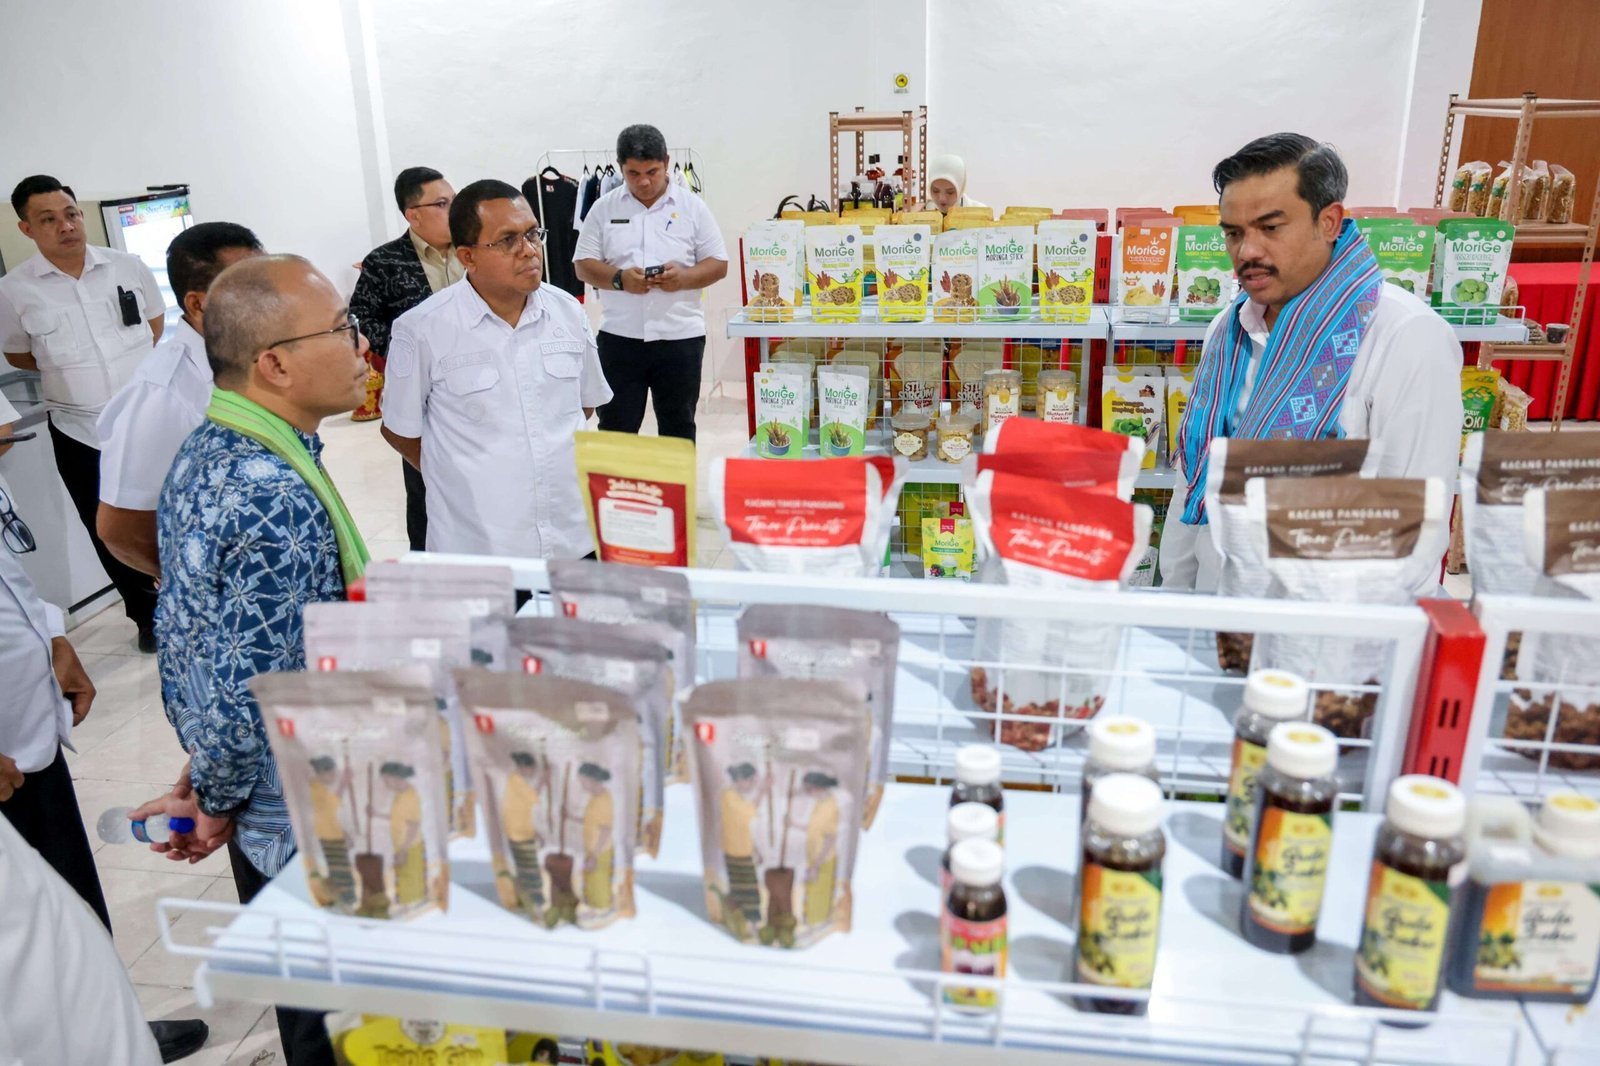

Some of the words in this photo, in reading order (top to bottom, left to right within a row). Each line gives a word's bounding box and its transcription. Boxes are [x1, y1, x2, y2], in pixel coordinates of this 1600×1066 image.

[749, 247, 787, 257] MoriGe
[815, 246, 855, 257] MoriGe
[881, 244, 922, 255] MoriGe
[939, 246, 978, 256] MoriGe
[985, 243, 1024, 254] MoriGe
[1044, 245, 1087, 255] MoriGe
[1127, 245, 1166, 256] MoriGe
[1185, 241, 1226, 252] MoriGe
[1379, 241, 1424, 252] MoriGe
[1452, 242, 1501, 254] MoriGe
[760, 388, 795, 399] MoriGe
[825, 388, 858, 400] MoriGe
[1287, 509, 1333, 520] KACANG
[1337, 508, 1400, 520] PANGGANG
